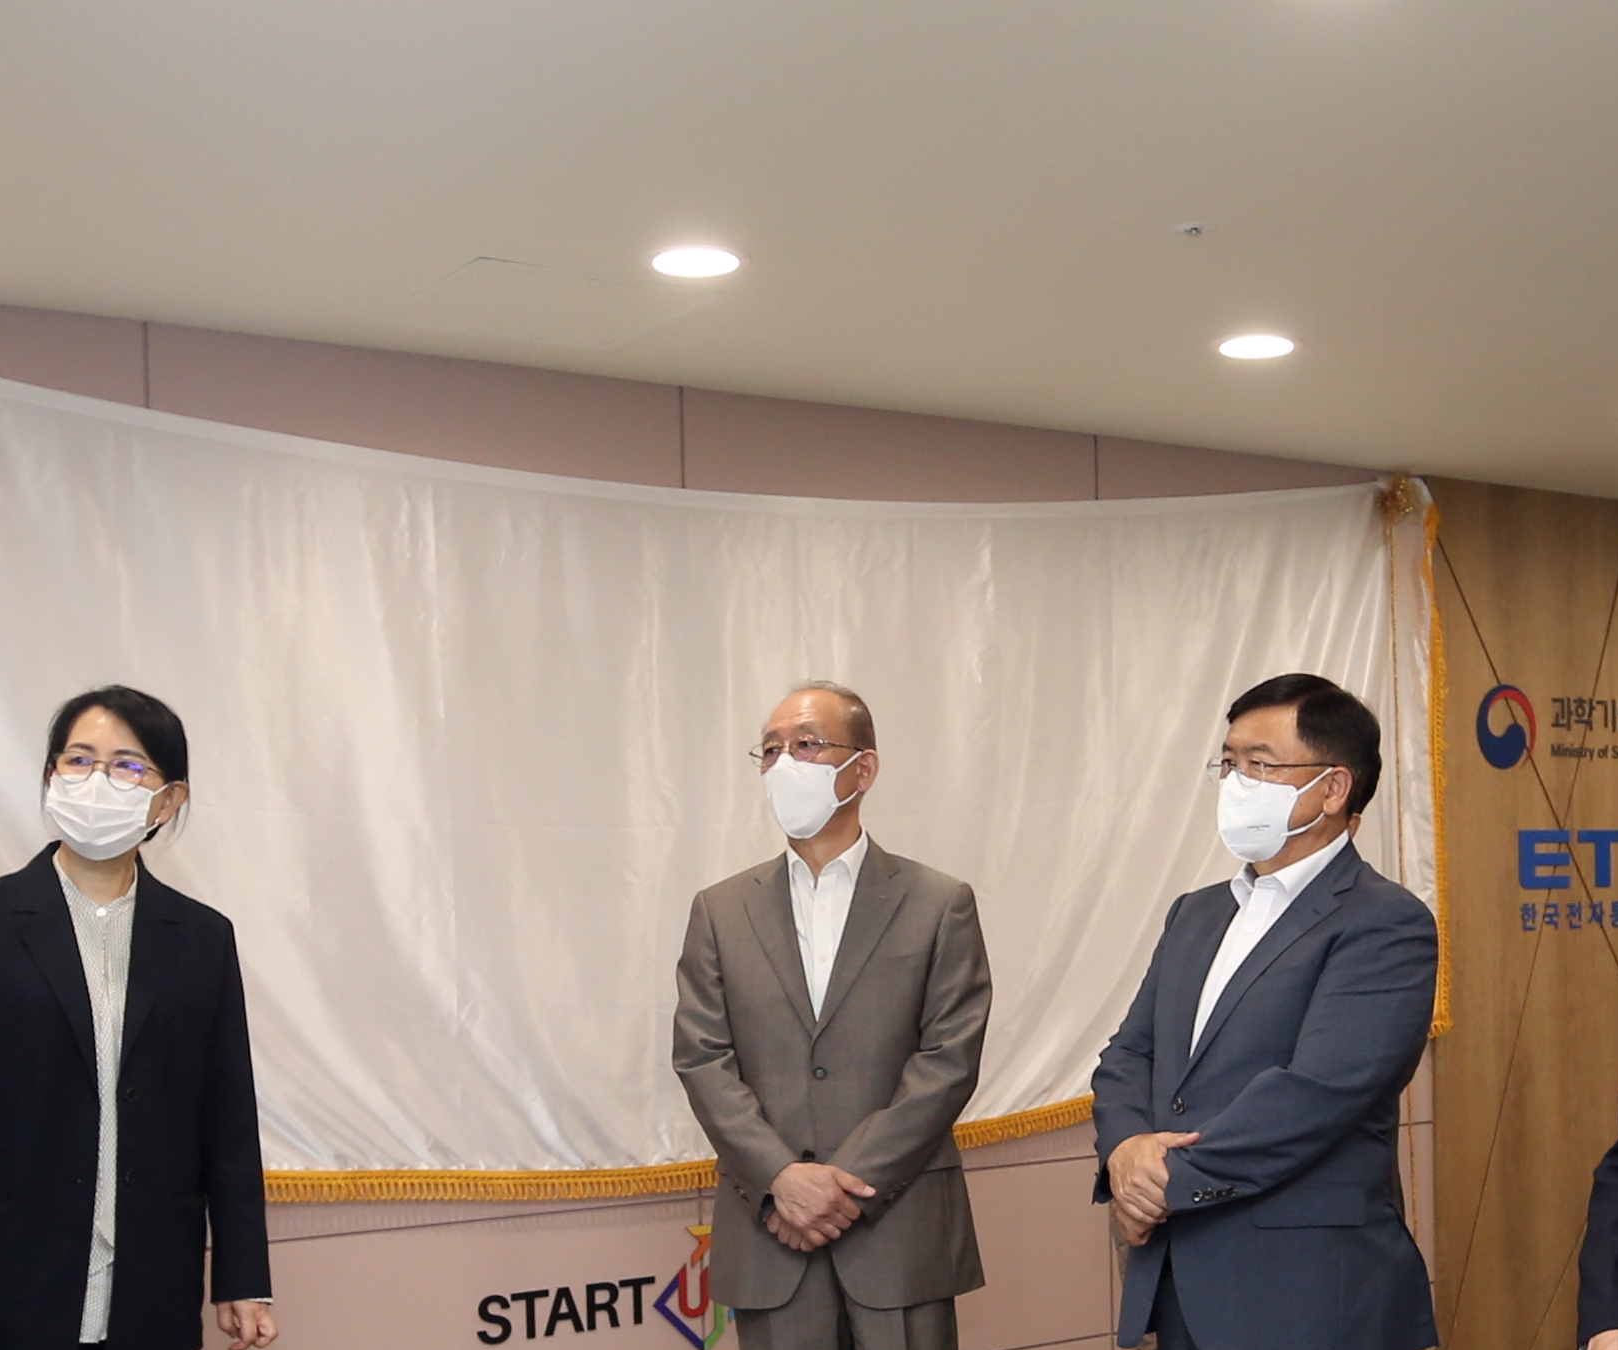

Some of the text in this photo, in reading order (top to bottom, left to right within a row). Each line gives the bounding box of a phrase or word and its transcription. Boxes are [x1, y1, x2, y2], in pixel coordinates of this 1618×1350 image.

[1550, 743, 1595, 762] Ministry
[1597, 743, 1609, 760] of
[476, 1275, 656, 1345] START
